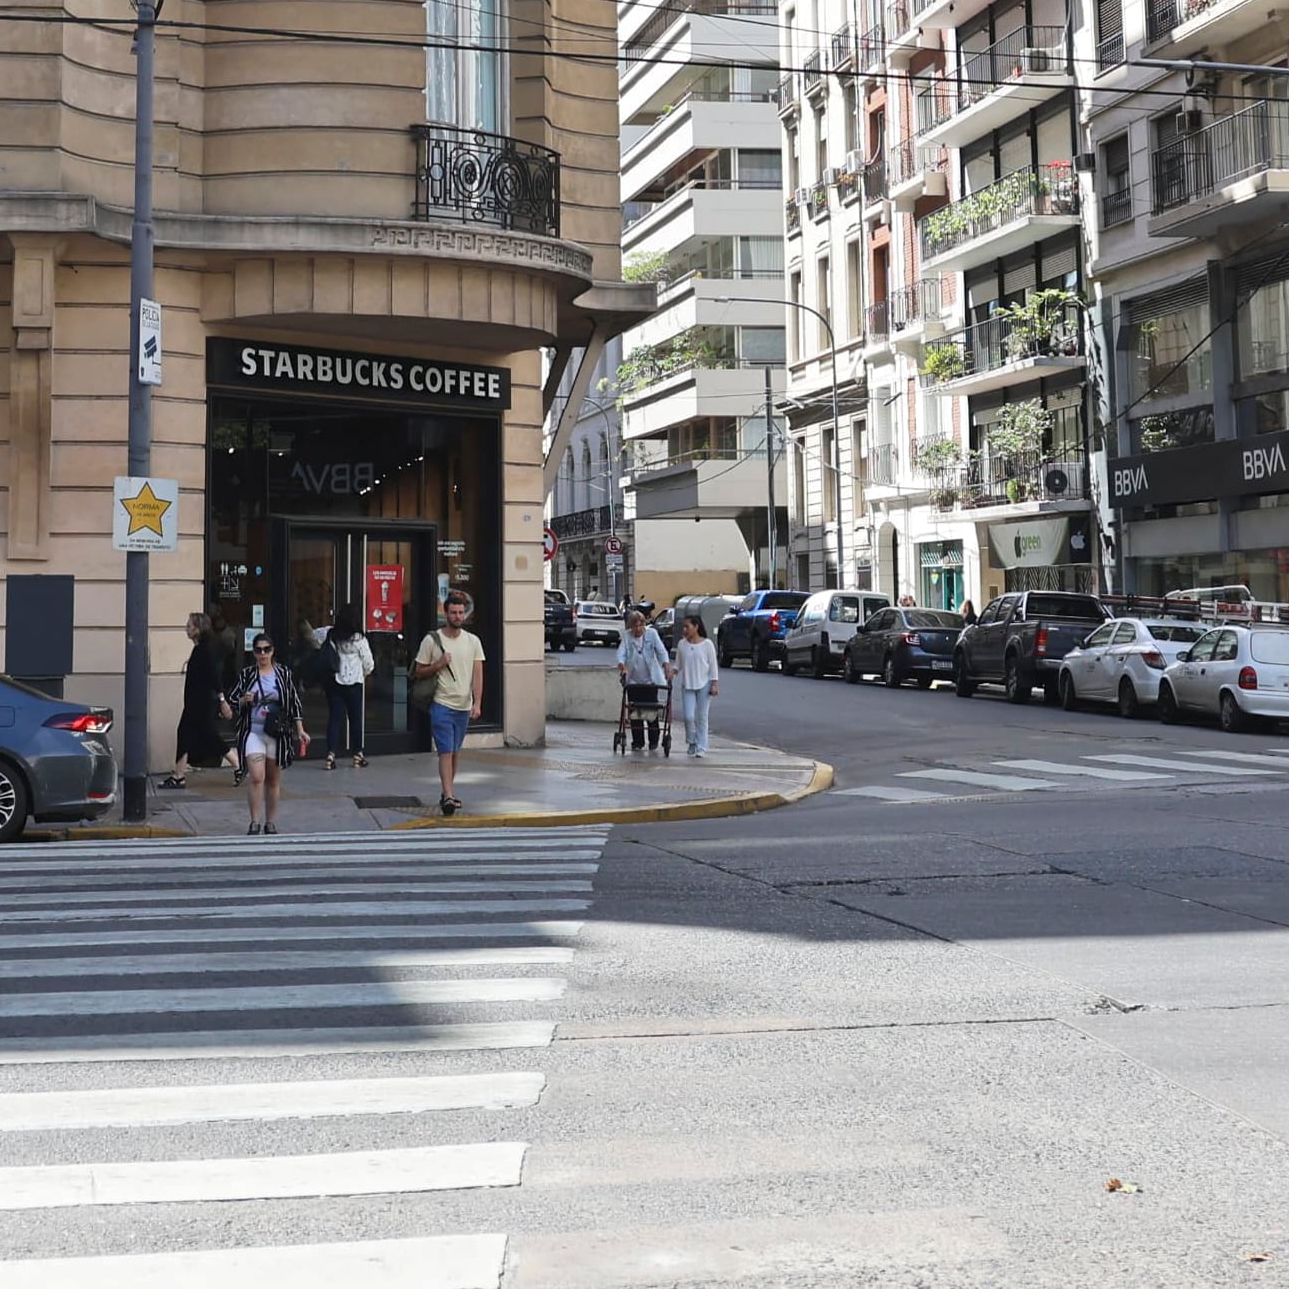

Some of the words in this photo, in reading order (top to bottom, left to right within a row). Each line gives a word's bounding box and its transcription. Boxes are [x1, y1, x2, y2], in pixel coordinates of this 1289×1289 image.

[241, 347, 404, 390] STARBUCKS
[409, 365, 501, 399] COFFEE
[1243, 442, 1287, 481] BBVA
[1114, 464, 1150, 497] BBVA
[1022, 535, 1041, 550] green
